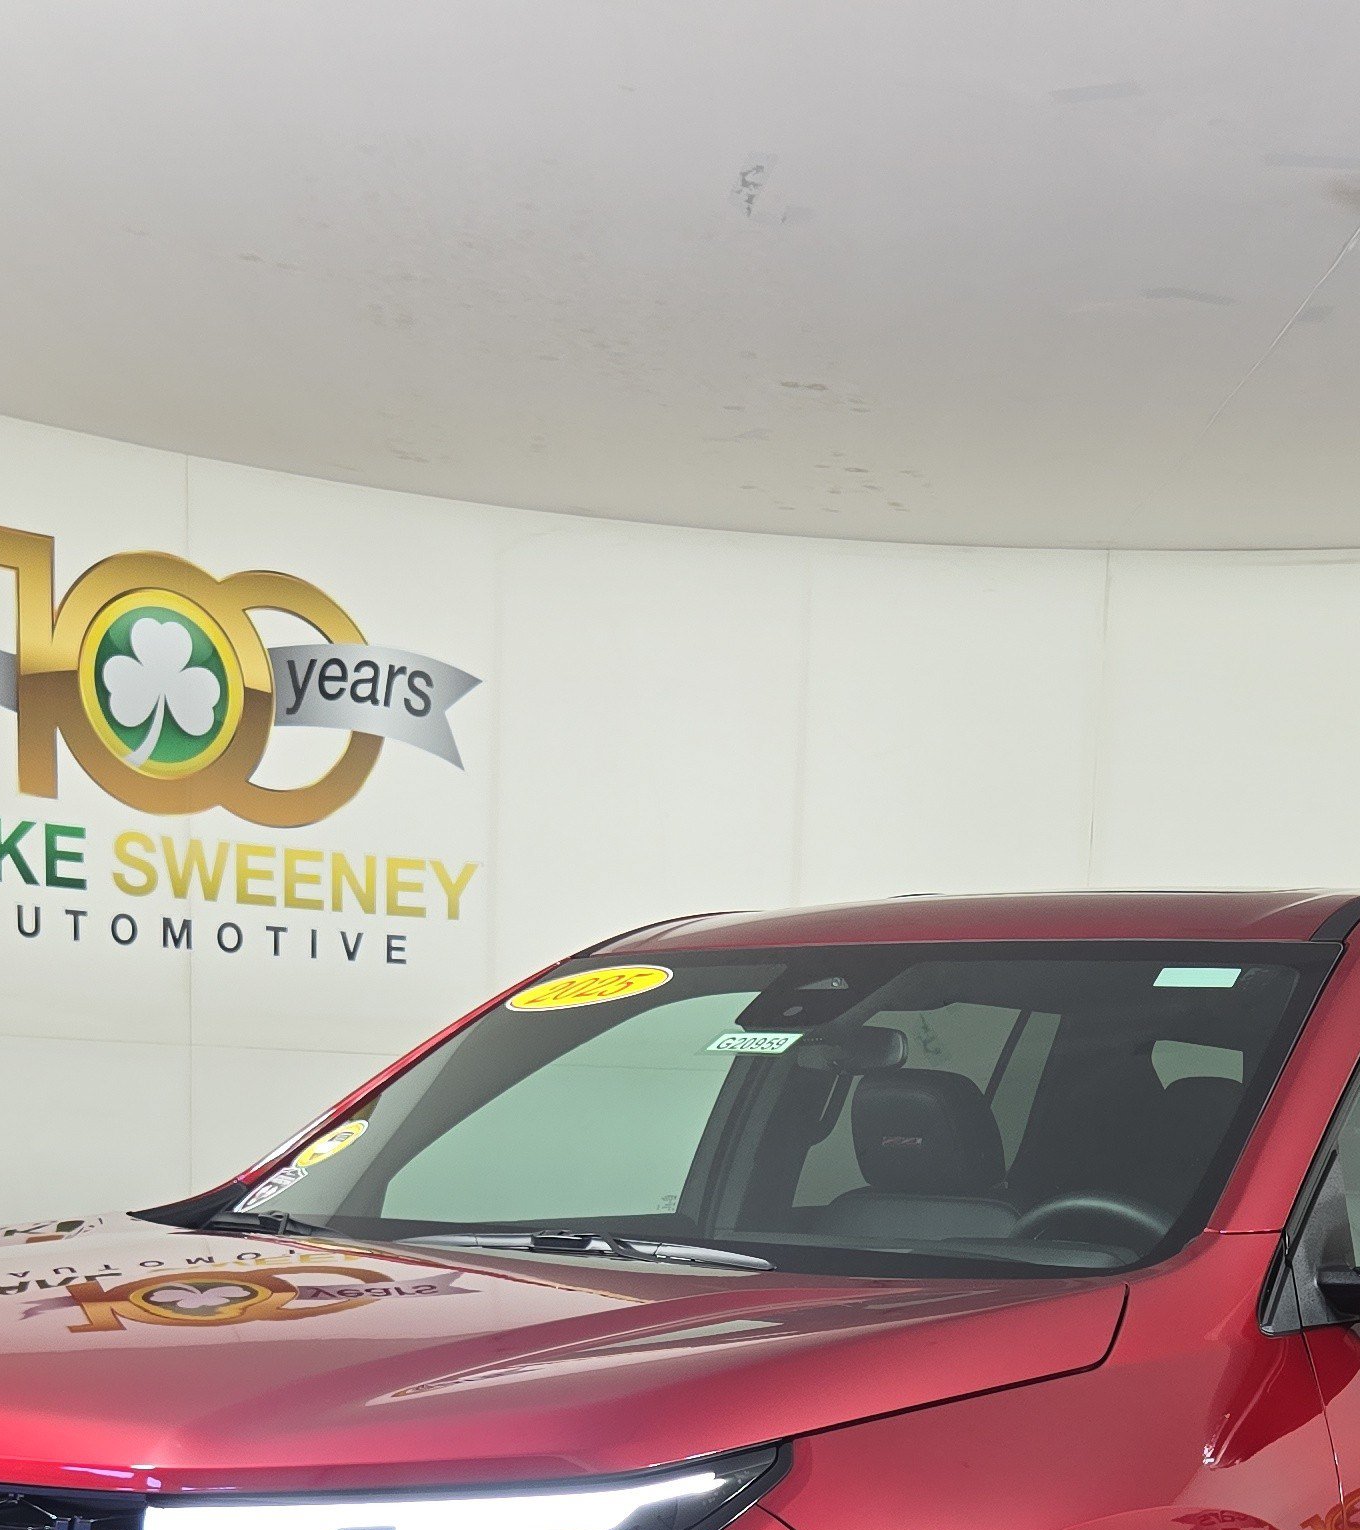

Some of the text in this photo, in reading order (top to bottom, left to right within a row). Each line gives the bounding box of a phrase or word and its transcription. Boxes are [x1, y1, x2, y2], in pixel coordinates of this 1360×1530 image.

[286, 656, 435, 717] years
[112, 831, 480, 921] SWEENEY
[524, 973, 654, 1005] 2025
